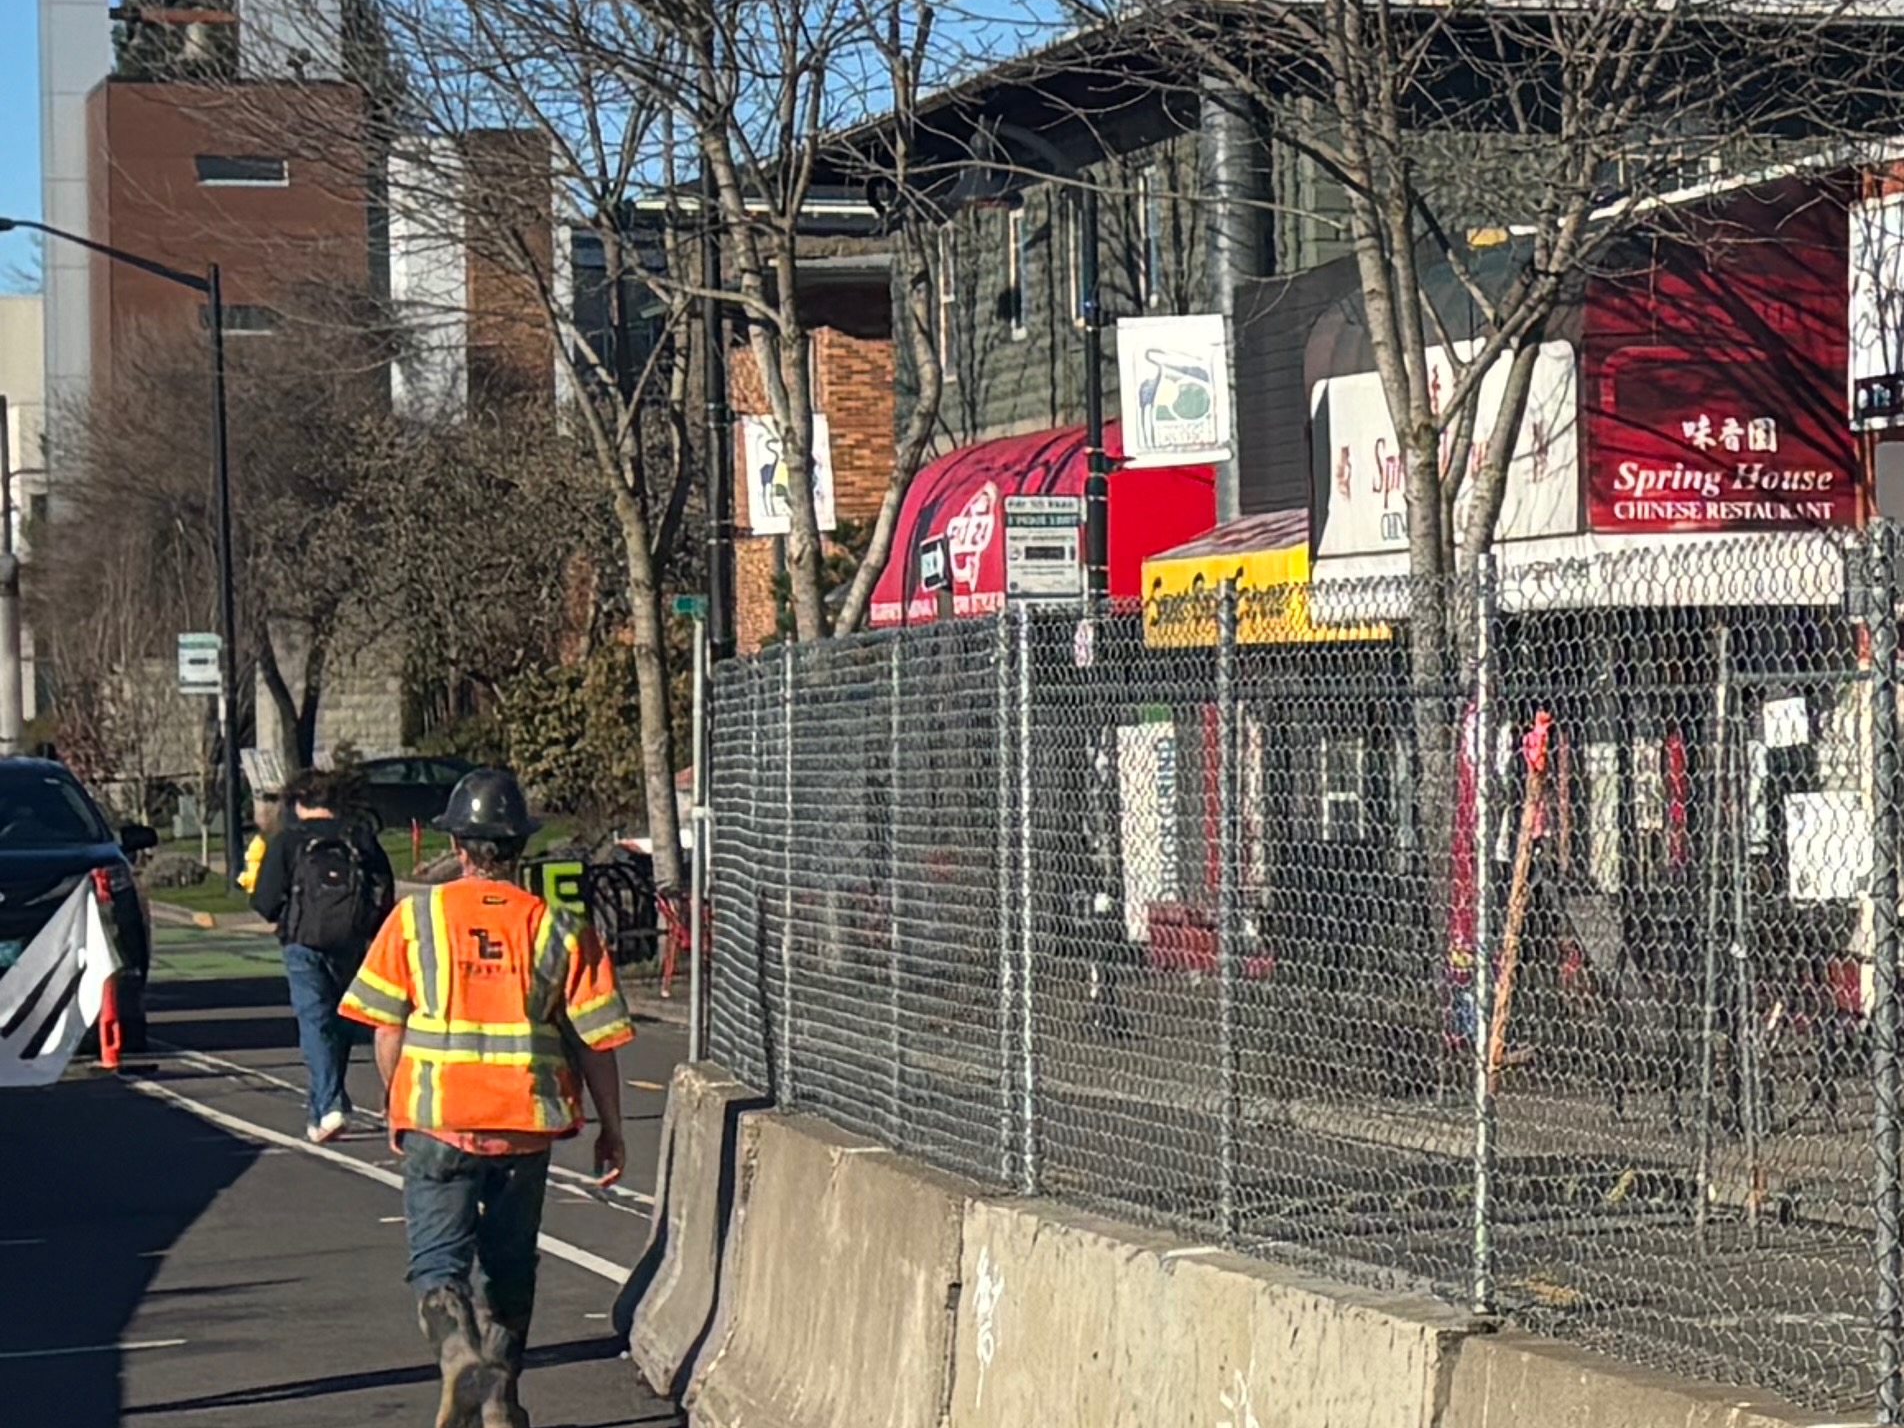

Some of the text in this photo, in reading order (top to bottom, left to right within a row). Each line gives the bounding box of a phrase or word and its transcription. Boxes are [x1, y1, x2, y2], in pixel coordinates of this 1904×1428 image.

[1614, 461, 1834, 498] Spring House
[1613, 501, 1835, 521] CHINESE RESTAURANT
